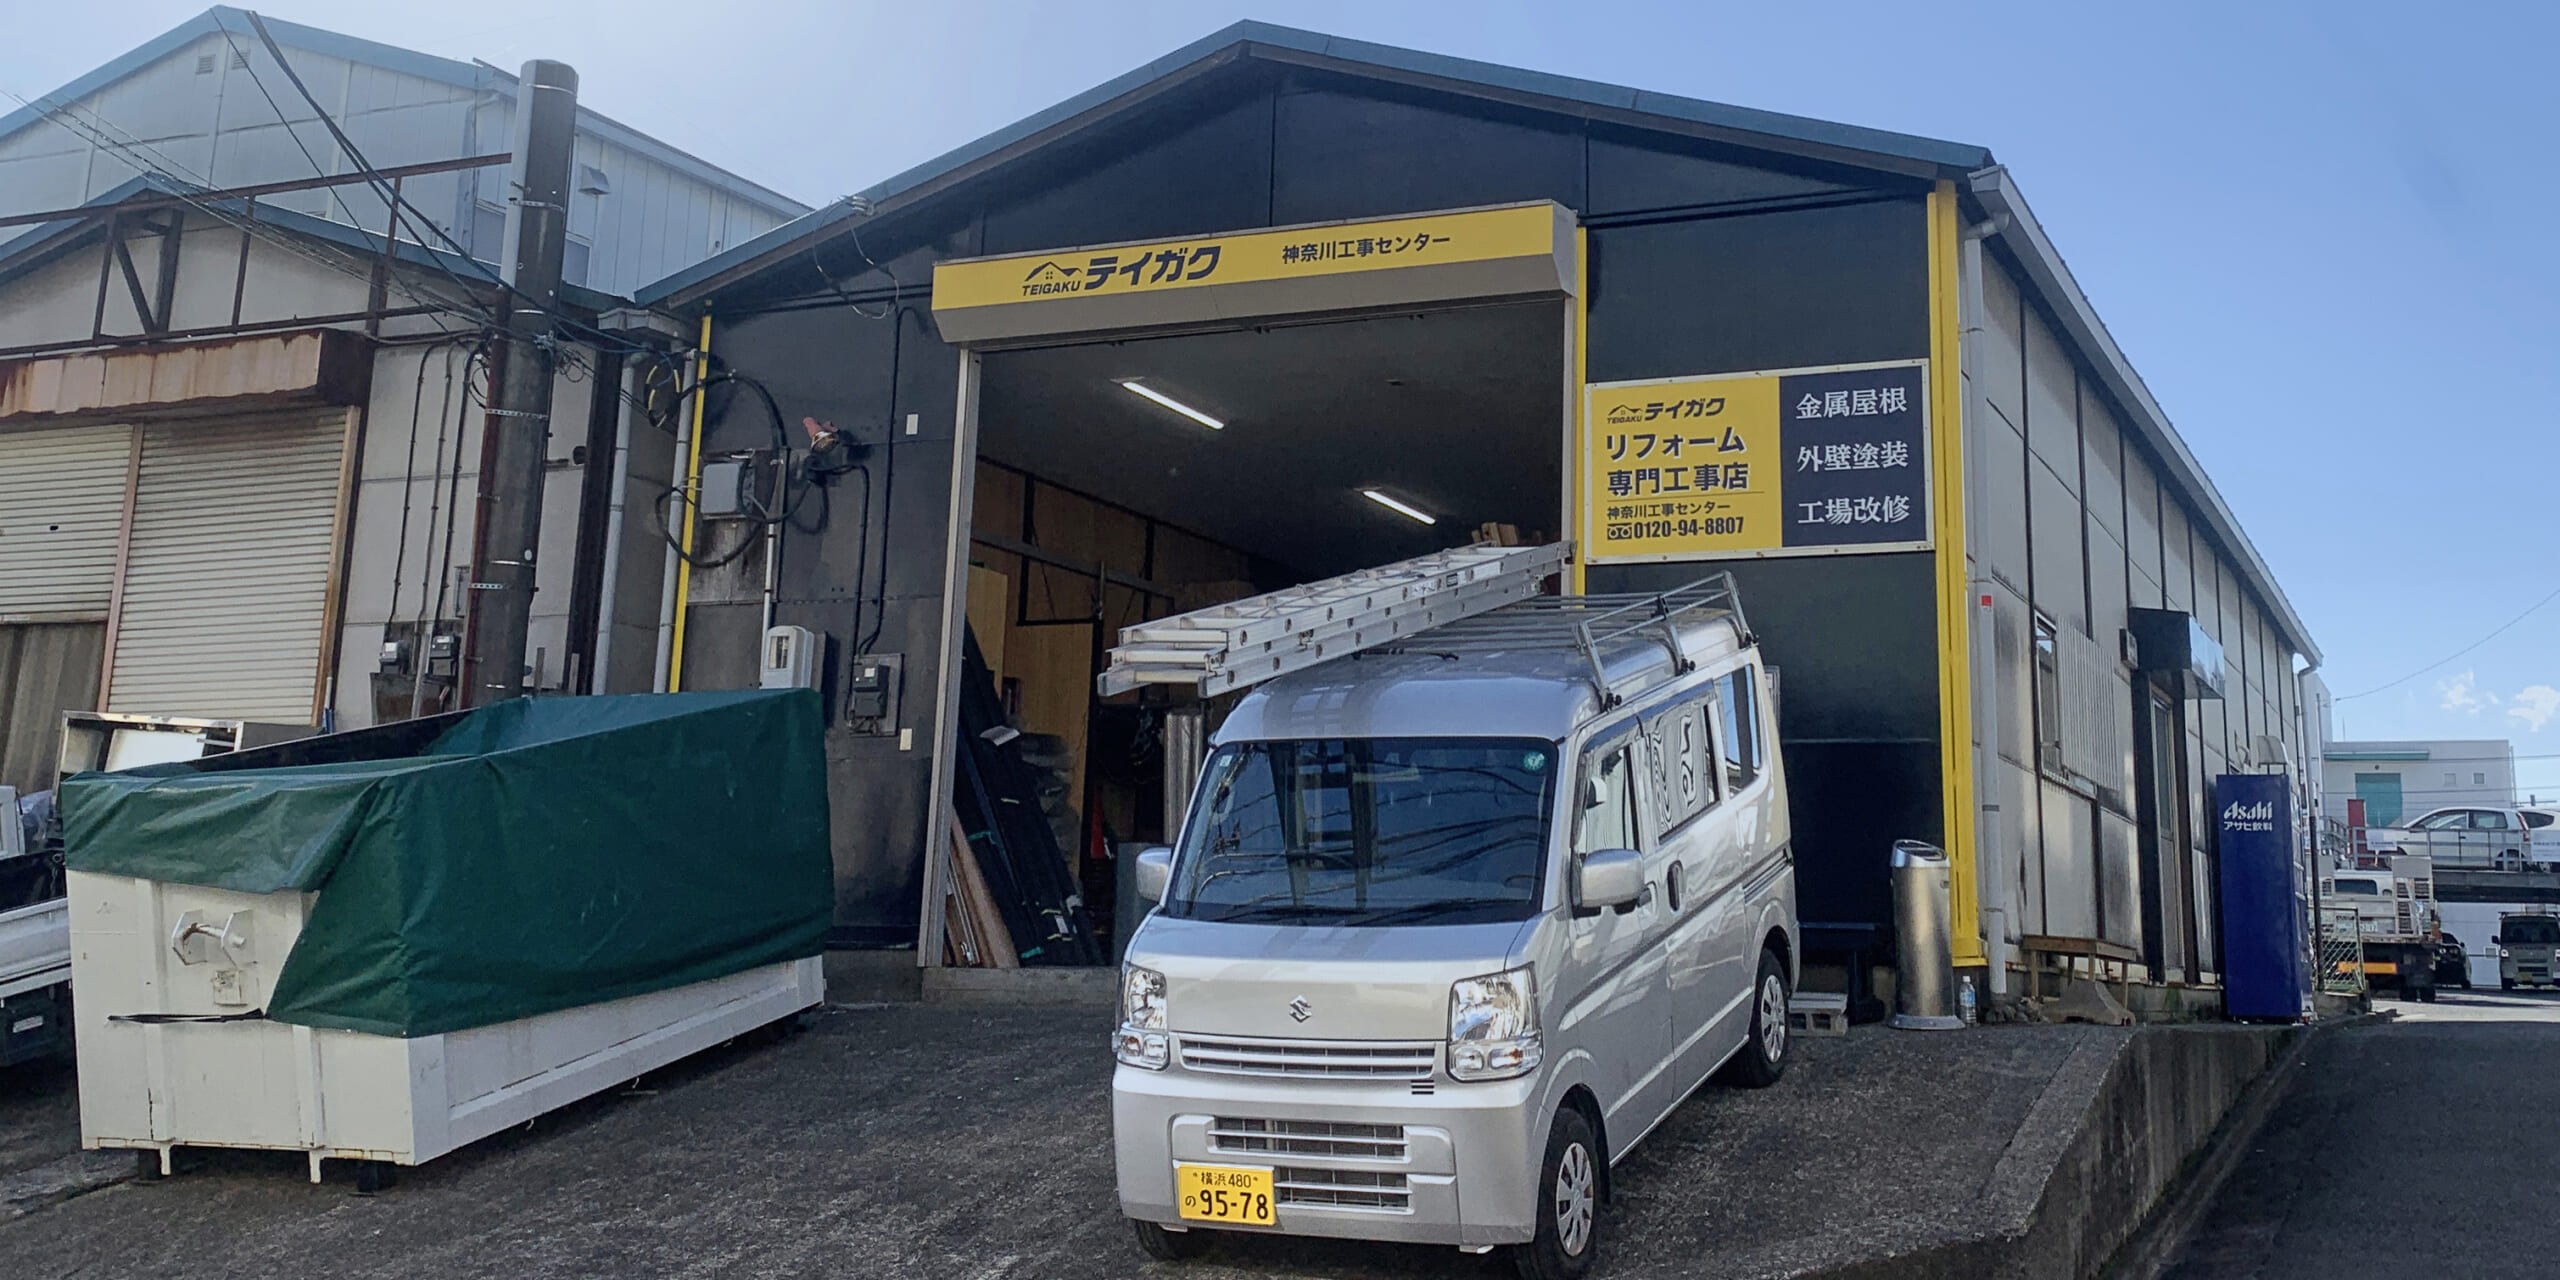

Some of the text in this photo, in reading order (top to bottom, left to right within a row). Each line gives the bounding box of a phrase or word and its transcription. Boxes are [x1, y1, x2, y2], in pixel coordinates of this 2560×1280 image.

[1282, 233, 1450, 264] 神奈川工事センター
[1084, 246, 1221, 290] テイガク
[1022, 280, 1081, 296] TEIGAKU
[1644, 397, 1726, 421] テイガク
[1796, 387, 1907, 419] 金属屋根
[1606, 426, 1747, 462] リフォーム
[1797, 440, 1909, 472] 外壁塗装
[1607, 461, 1750, 497] 専門工事店
[1607, 501, 1731, 520] 神奈川工事センター
[1797, 495, 1910, 525] 工場改修
[1634, 517, 1744, 539] 0120-94-8807
[2223, 800, 2273, 820] Asahi
[2223, 821, 2273, 831] アサヒ飲料
[1200, 1189, 1268, 1220] 95-78
